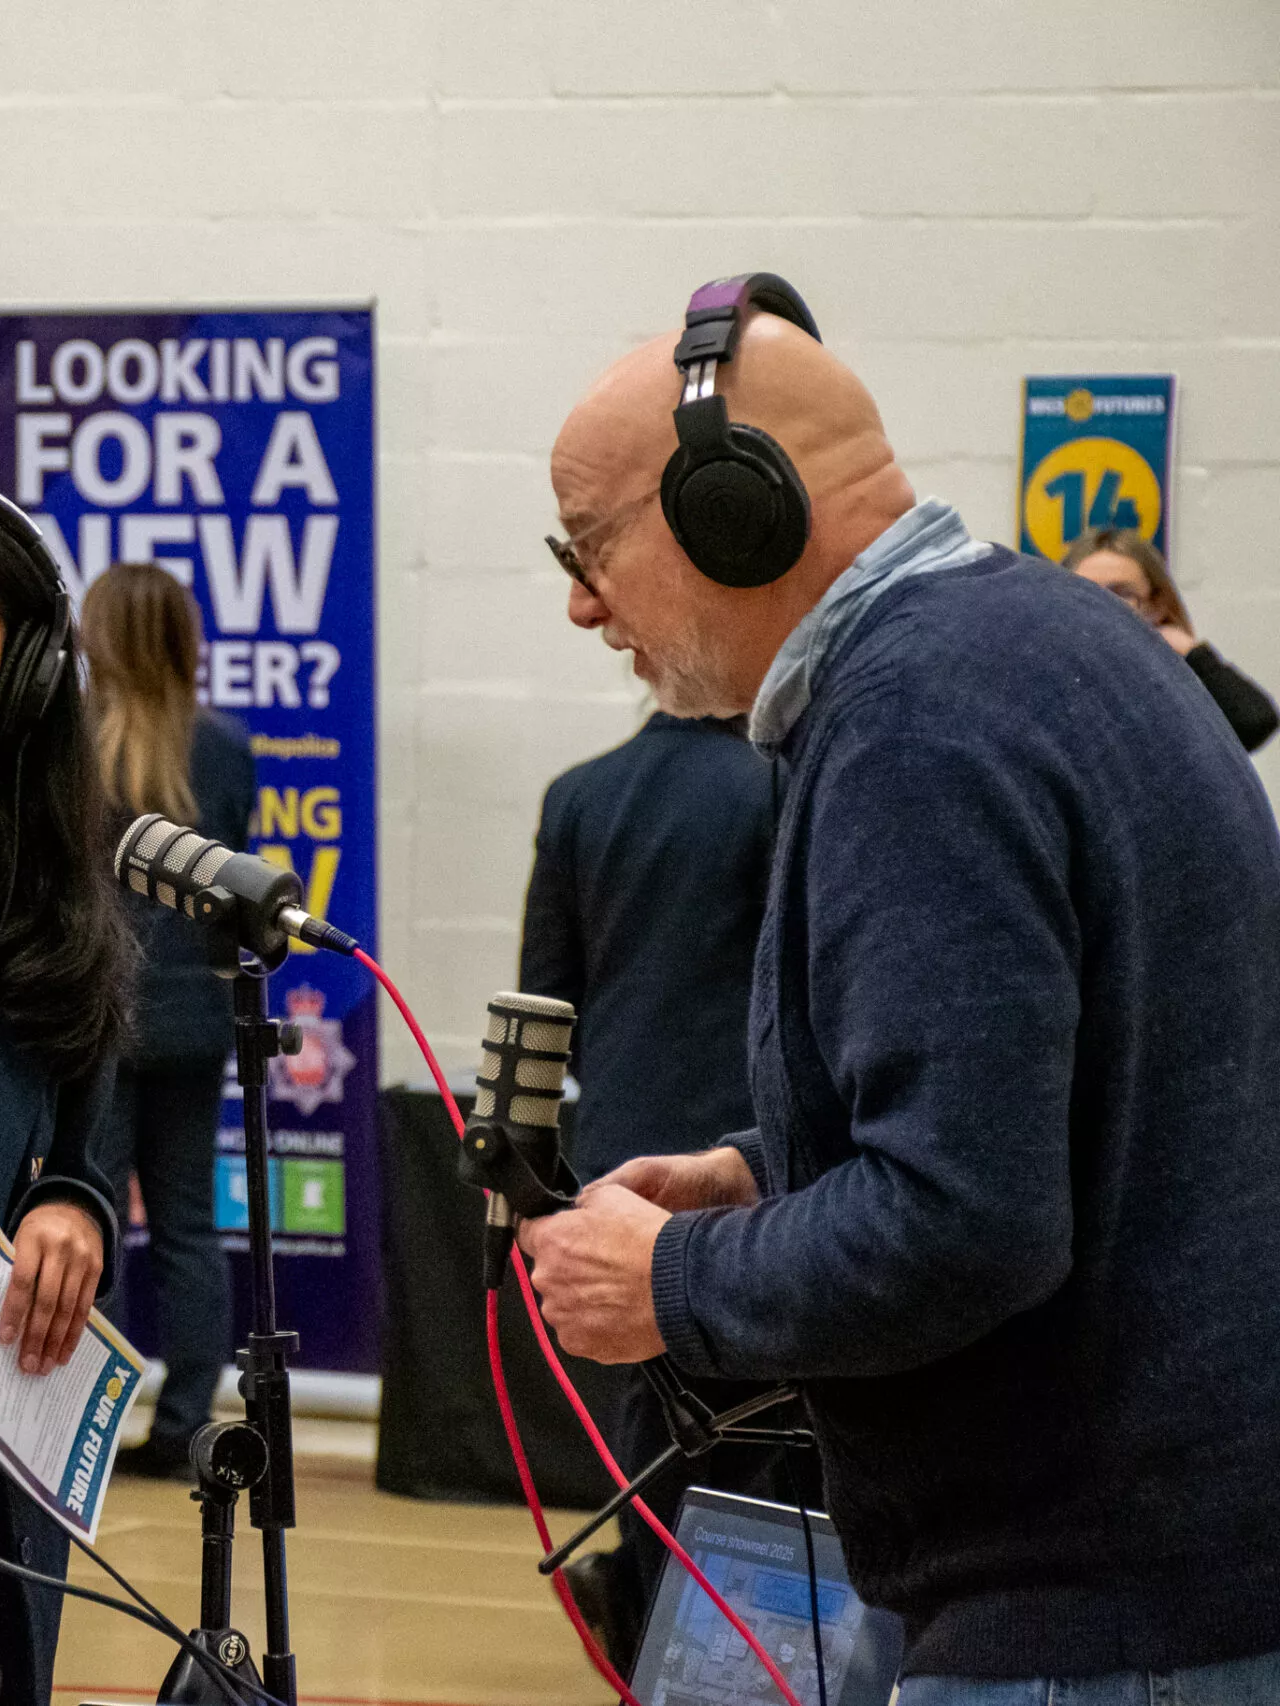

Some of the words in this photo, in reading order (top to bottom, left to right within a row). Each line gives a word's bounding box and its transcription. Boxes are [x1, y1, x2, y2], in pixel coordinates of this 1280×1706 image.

[16, 337, 340, 404] LOOKING
[16, 410, 225, 507] FOR
[250, 410, 340, 506] A
[1044, 469, 1141, 543] 14
[65, 1433, 104, 1517] FUTURE
[694, 1526, 727, 1546] Course
[727, 1535, 770, 1556] showreel
[770, 1543, 797, 1562] 2025
[225, 1634, 240, 1668] K&M
